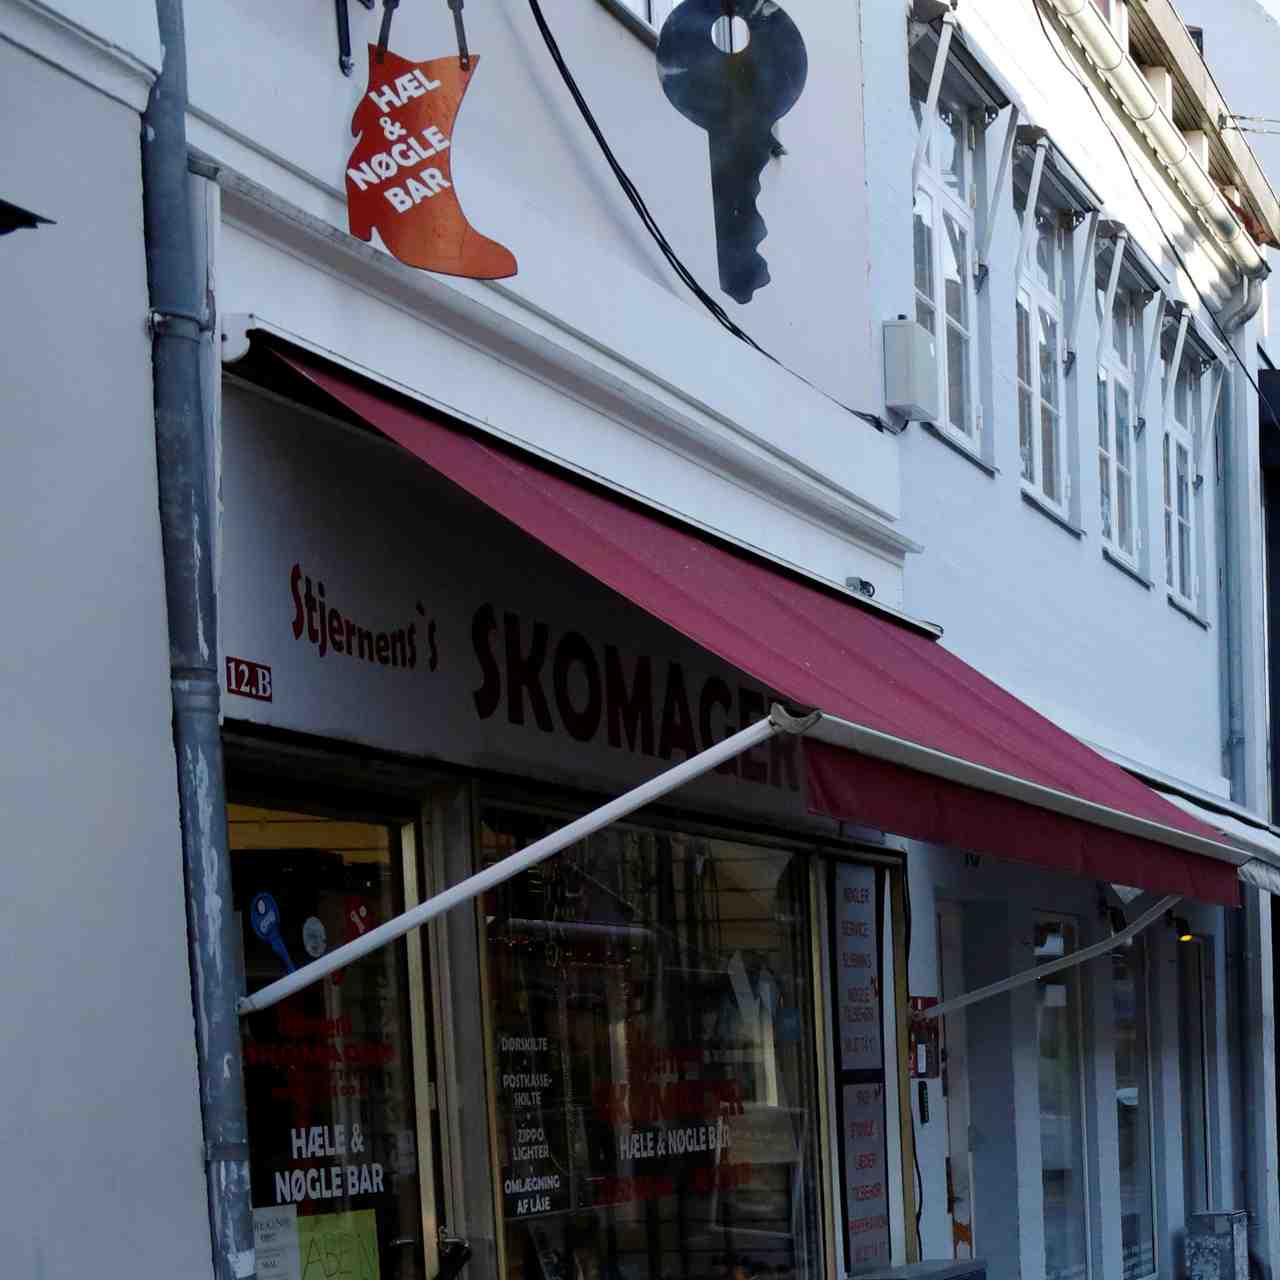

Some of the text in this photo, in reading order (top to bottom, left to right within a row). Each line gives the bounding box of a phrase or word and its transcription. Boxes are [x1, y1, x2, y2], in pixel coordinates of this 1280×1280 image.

[368, 69, 442, 113] HÆL
[379, 116, 407, 140] &
[347, 125, 450, 191] NØGLE
[384, 167, 451, 213] BAR
[227, 660, 271, 697] 12.B
[290, 1122, 365, 1160] HÆLE &
[512, 1144, 550, 1161] LIGHTER
[517, 1127, 545, 1145] ZIPPO
[619, 1131, 654, 1161] HÆLE
[655, 1132, 667, 1158] &
[667, 1127, 707, 1156] NØGLE
[274, 1162, 385, 1204] NØGLE BAR
[516, 1198, 530, 1215] AF
